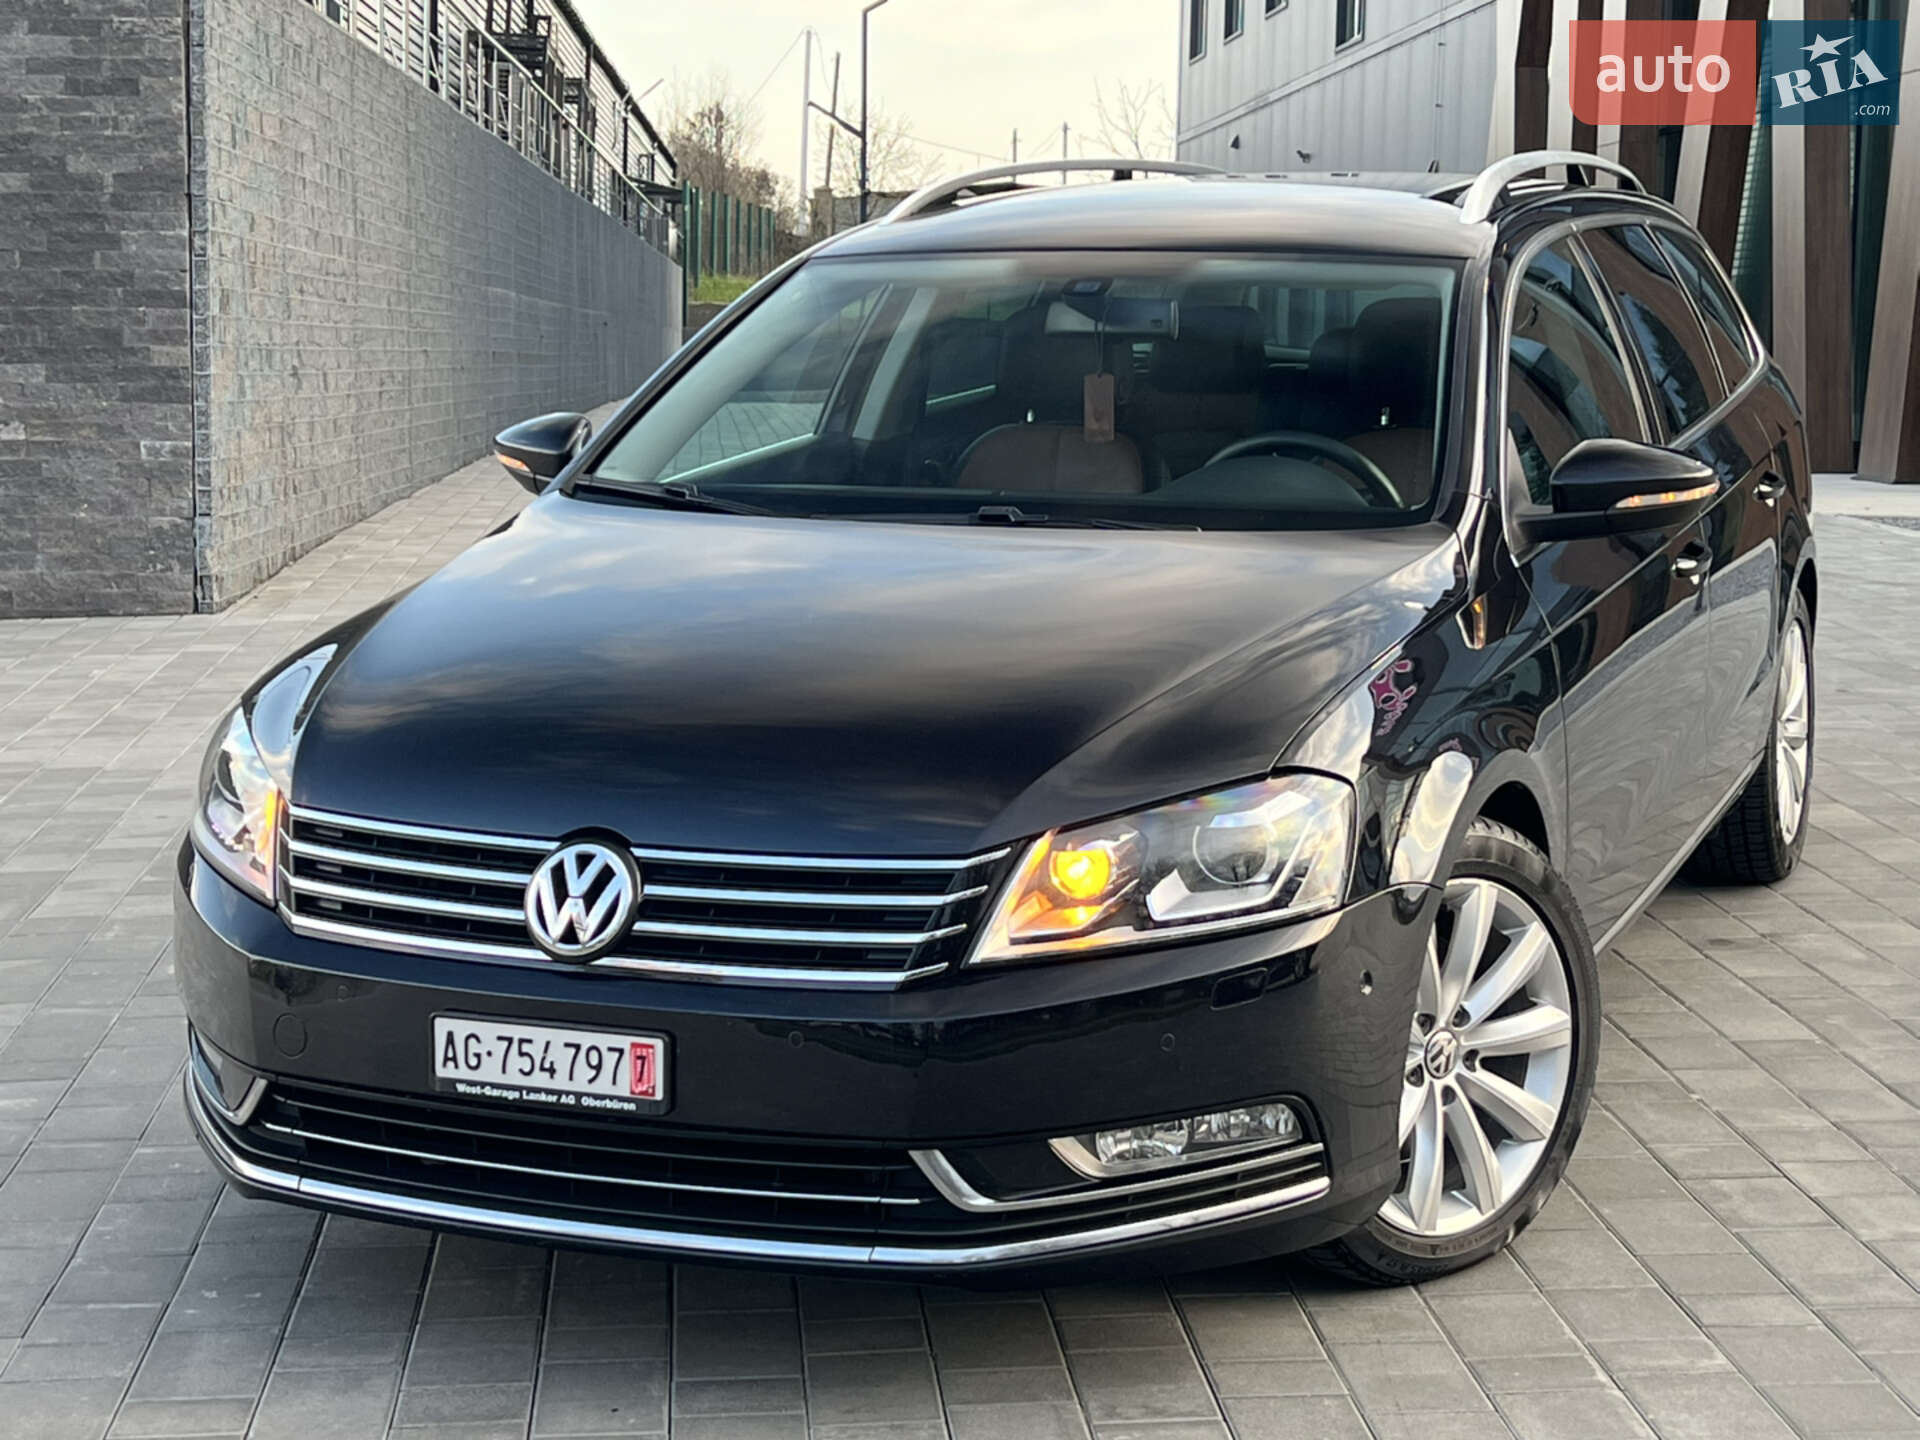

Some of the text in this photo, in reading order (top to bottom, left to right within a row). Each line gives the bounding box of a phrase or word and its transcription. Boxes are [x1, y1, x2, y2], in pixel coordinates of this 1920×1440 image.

[635, 1055, 647, 1082] 7
[456, 1082, 520, 1100] West-Garage
[559, 1094, 576, 1105] AG
[581, 1096, 636, 1111] Oberbüren
